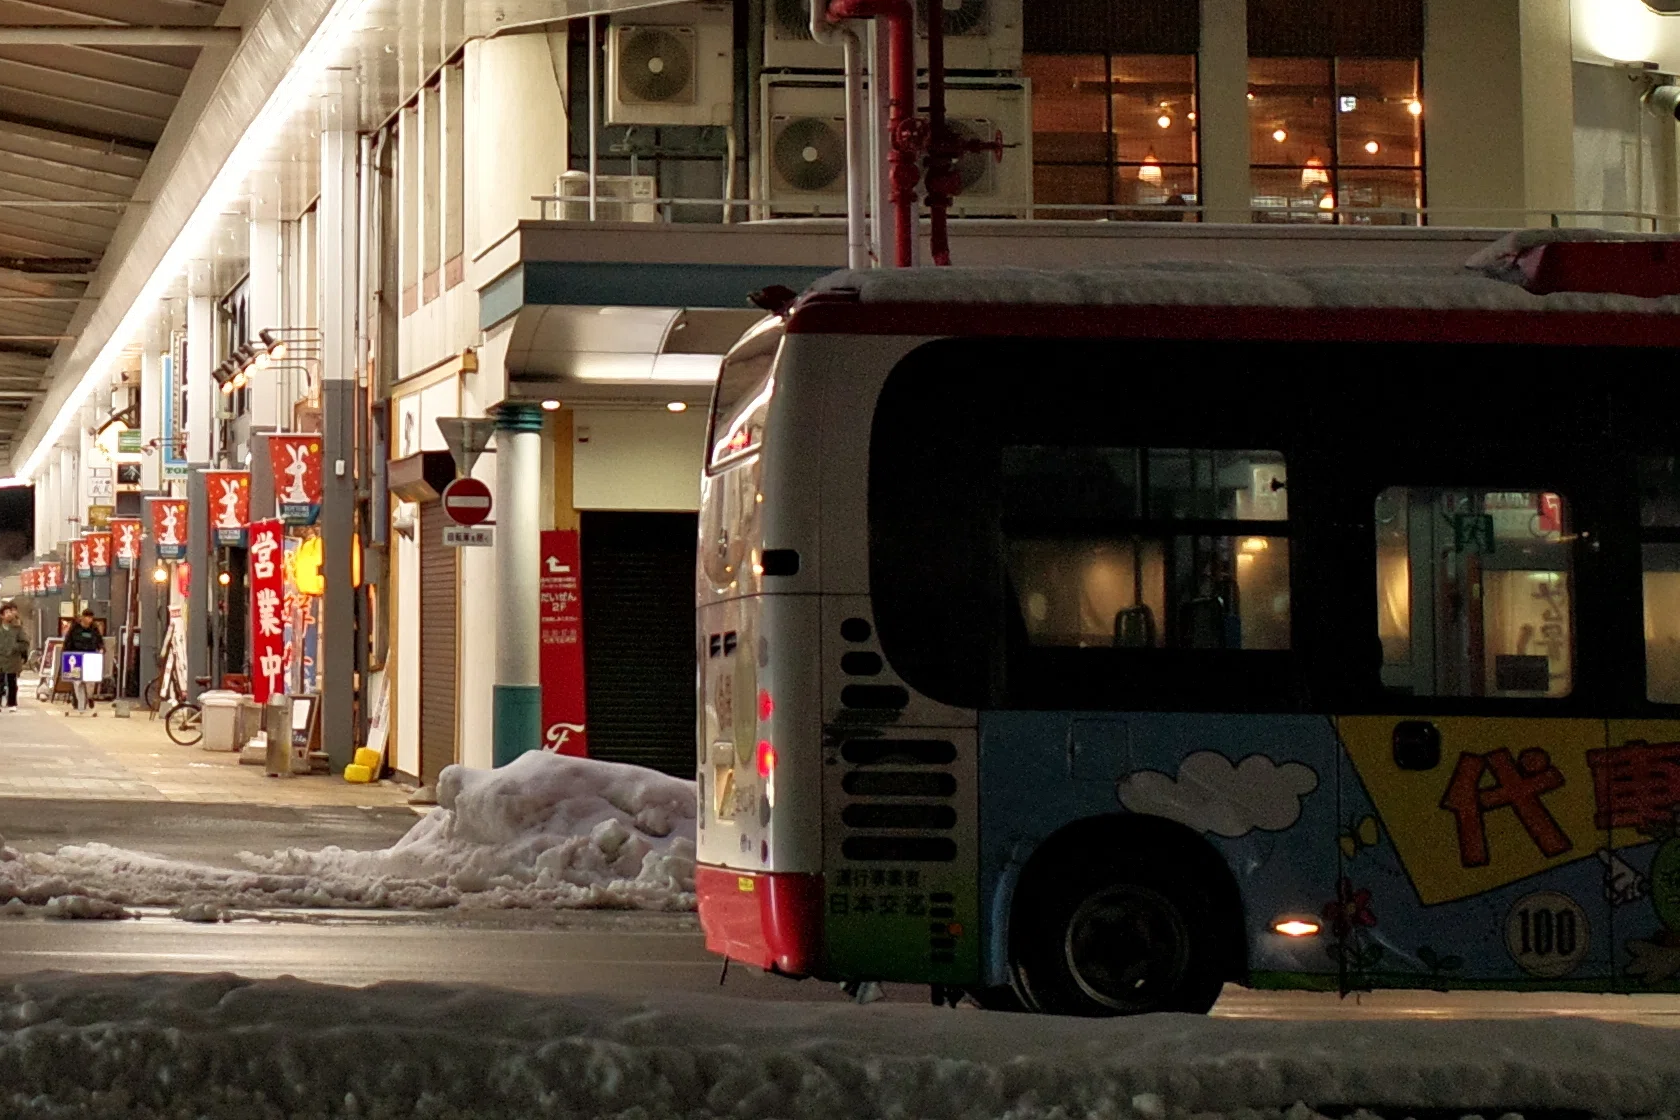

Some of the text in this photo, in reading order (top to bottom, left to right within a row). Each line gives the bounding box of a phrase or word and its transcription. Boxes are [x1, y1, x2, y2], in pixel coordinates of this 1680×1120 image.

[251, 530, 283, 696] 営業中
[1517, 907, 1576, 957] 100
